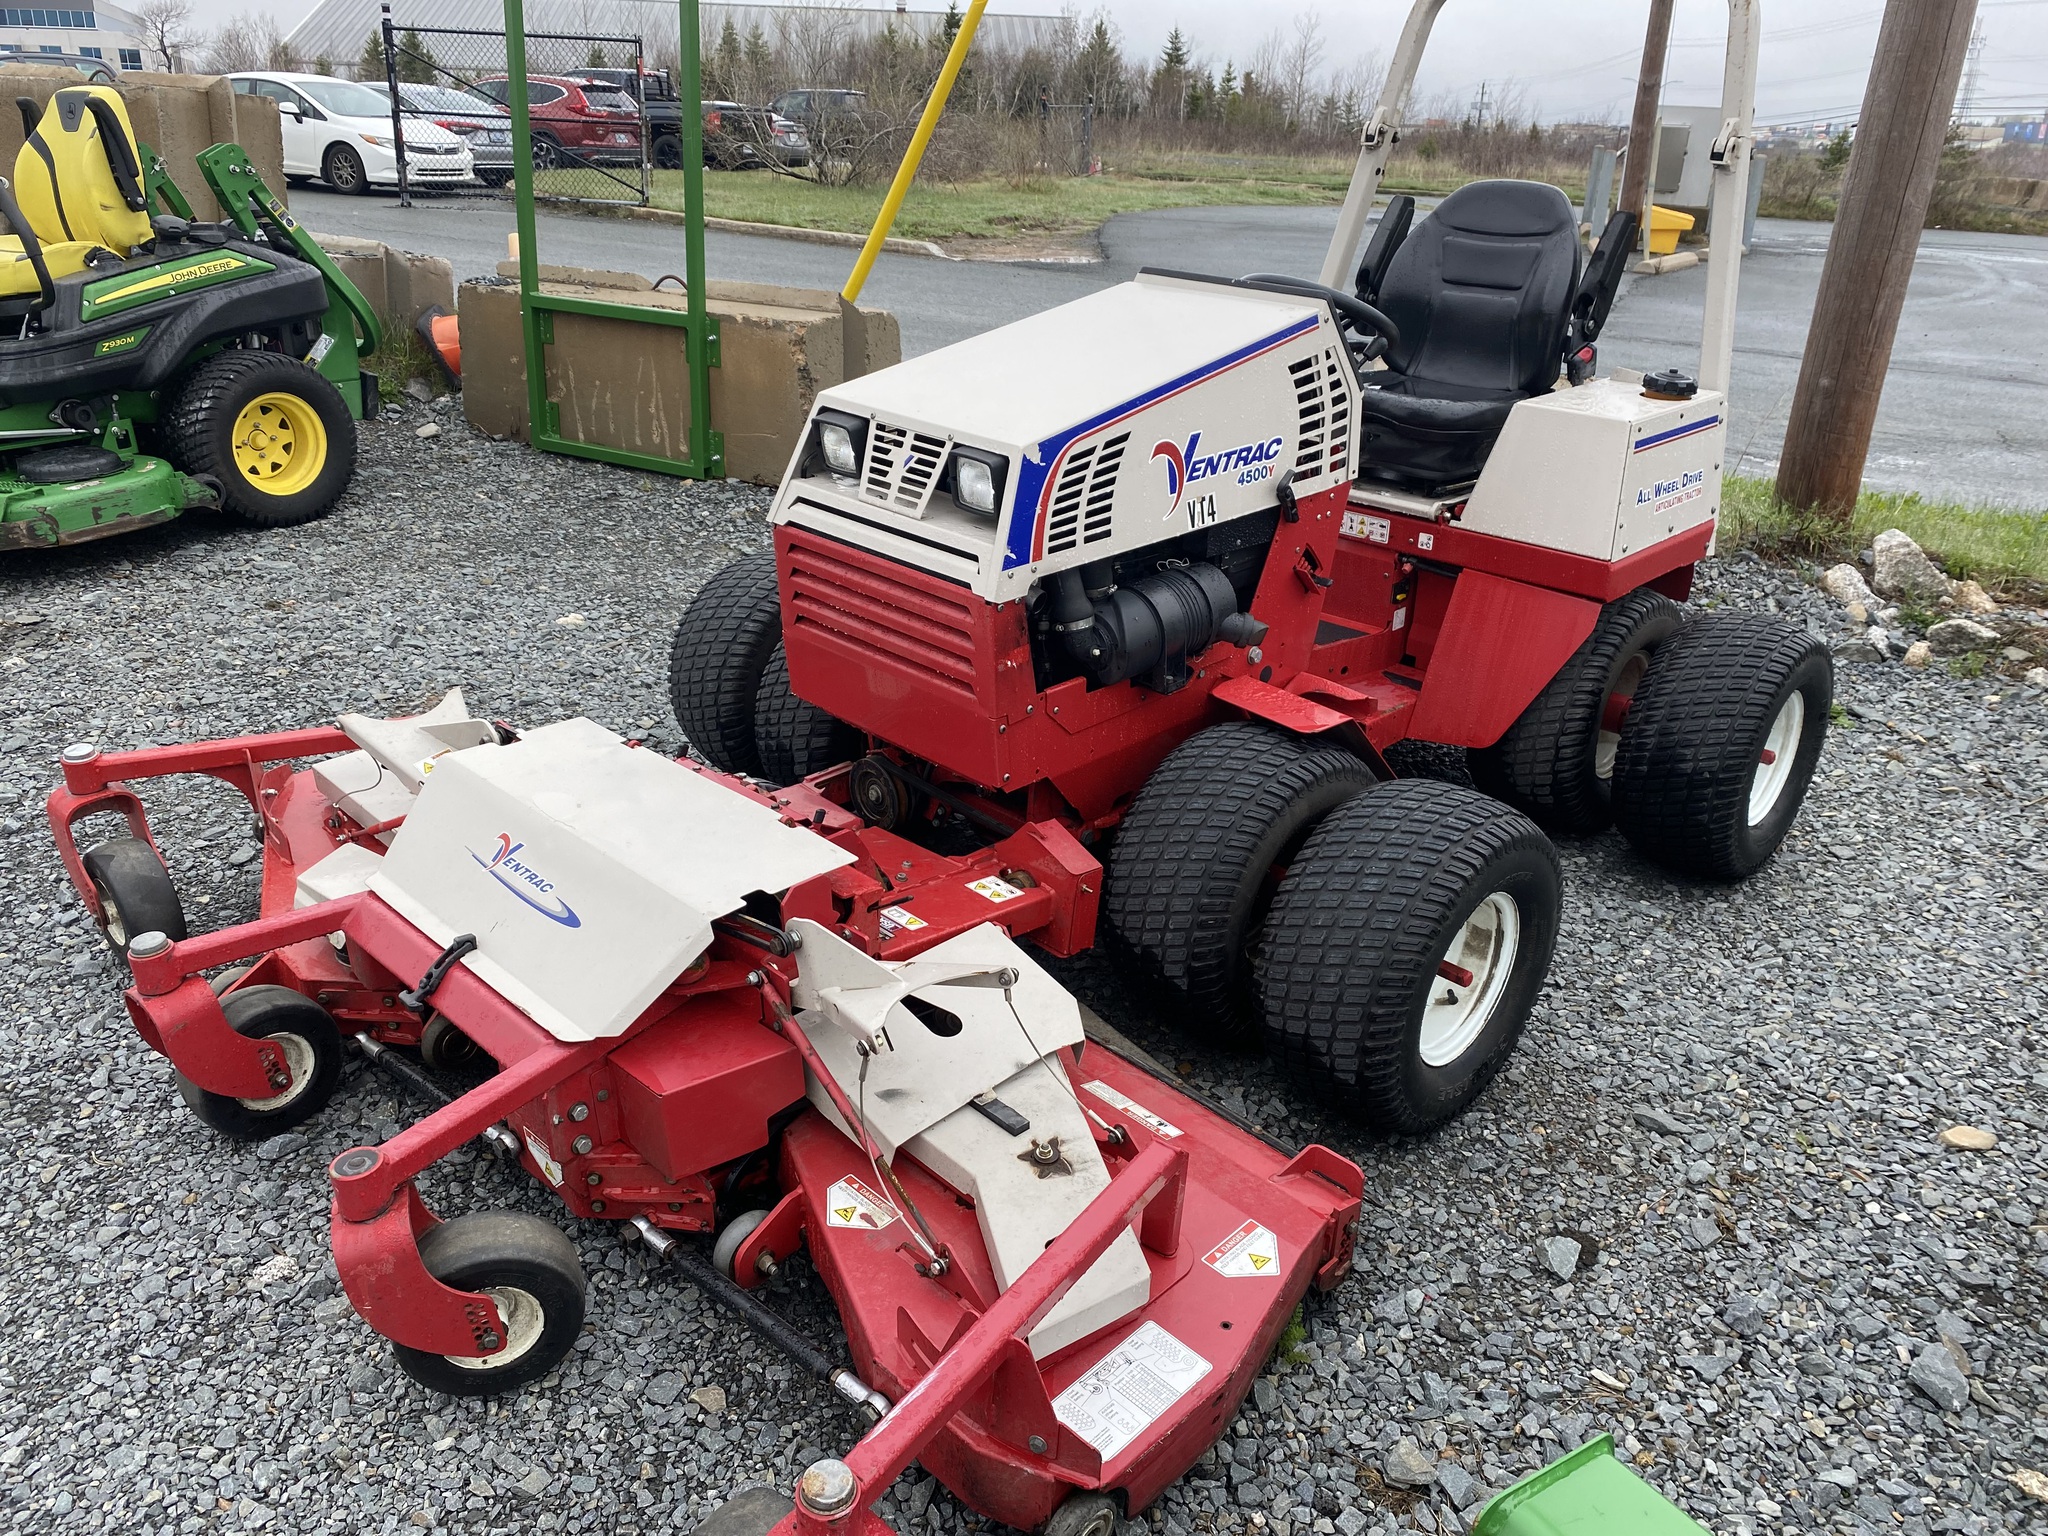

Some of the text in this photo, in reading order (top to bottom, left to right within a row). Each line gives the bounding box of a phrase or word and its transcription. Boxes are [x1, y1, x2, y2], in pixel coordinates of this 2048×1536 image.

[169, 260, 233, 284] JOHN DEERE
[102, 336, 135, 352] Z930M
[1150, 431, 1283, 520] VENTRAC
[1237, 464, 1276, 486] 4500Y
[1636, 470, 1703, 506] ALL WHEEL DRIVE
[484, 832, 555, 893] VENTRAC
[859, 1187, 886, 1210] DANGER
[1220, 1230, 1248, 1253] DANGER
